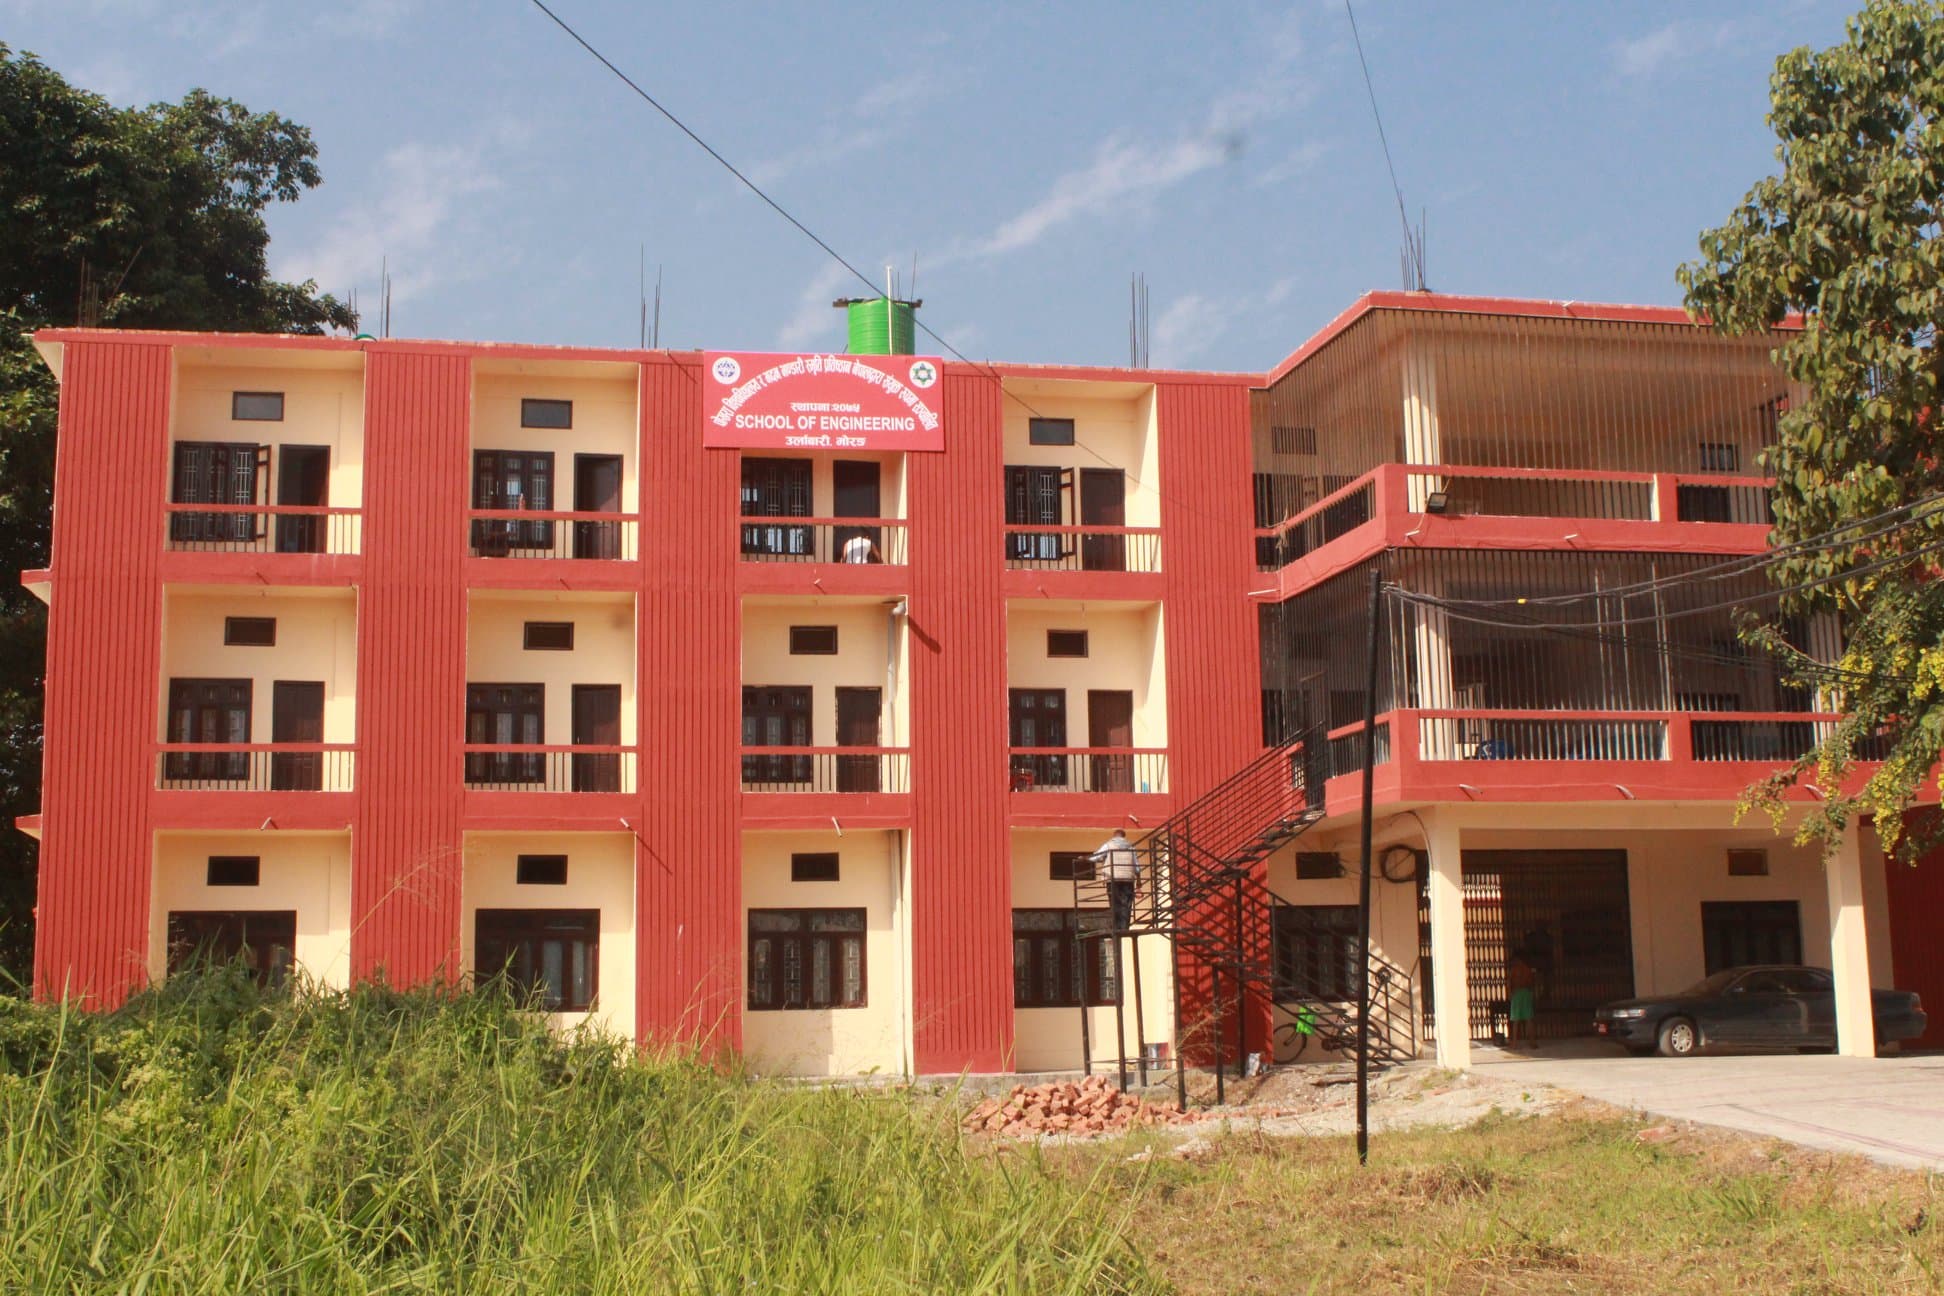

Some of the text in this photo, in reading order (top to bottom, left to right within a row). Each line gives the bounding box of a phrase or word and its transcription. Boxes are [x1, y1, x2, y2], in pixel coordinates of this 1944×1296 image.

[756, 374, 768, 388] र
[735, 414, 916, 432] SCHOOL OF ENGINEERING
